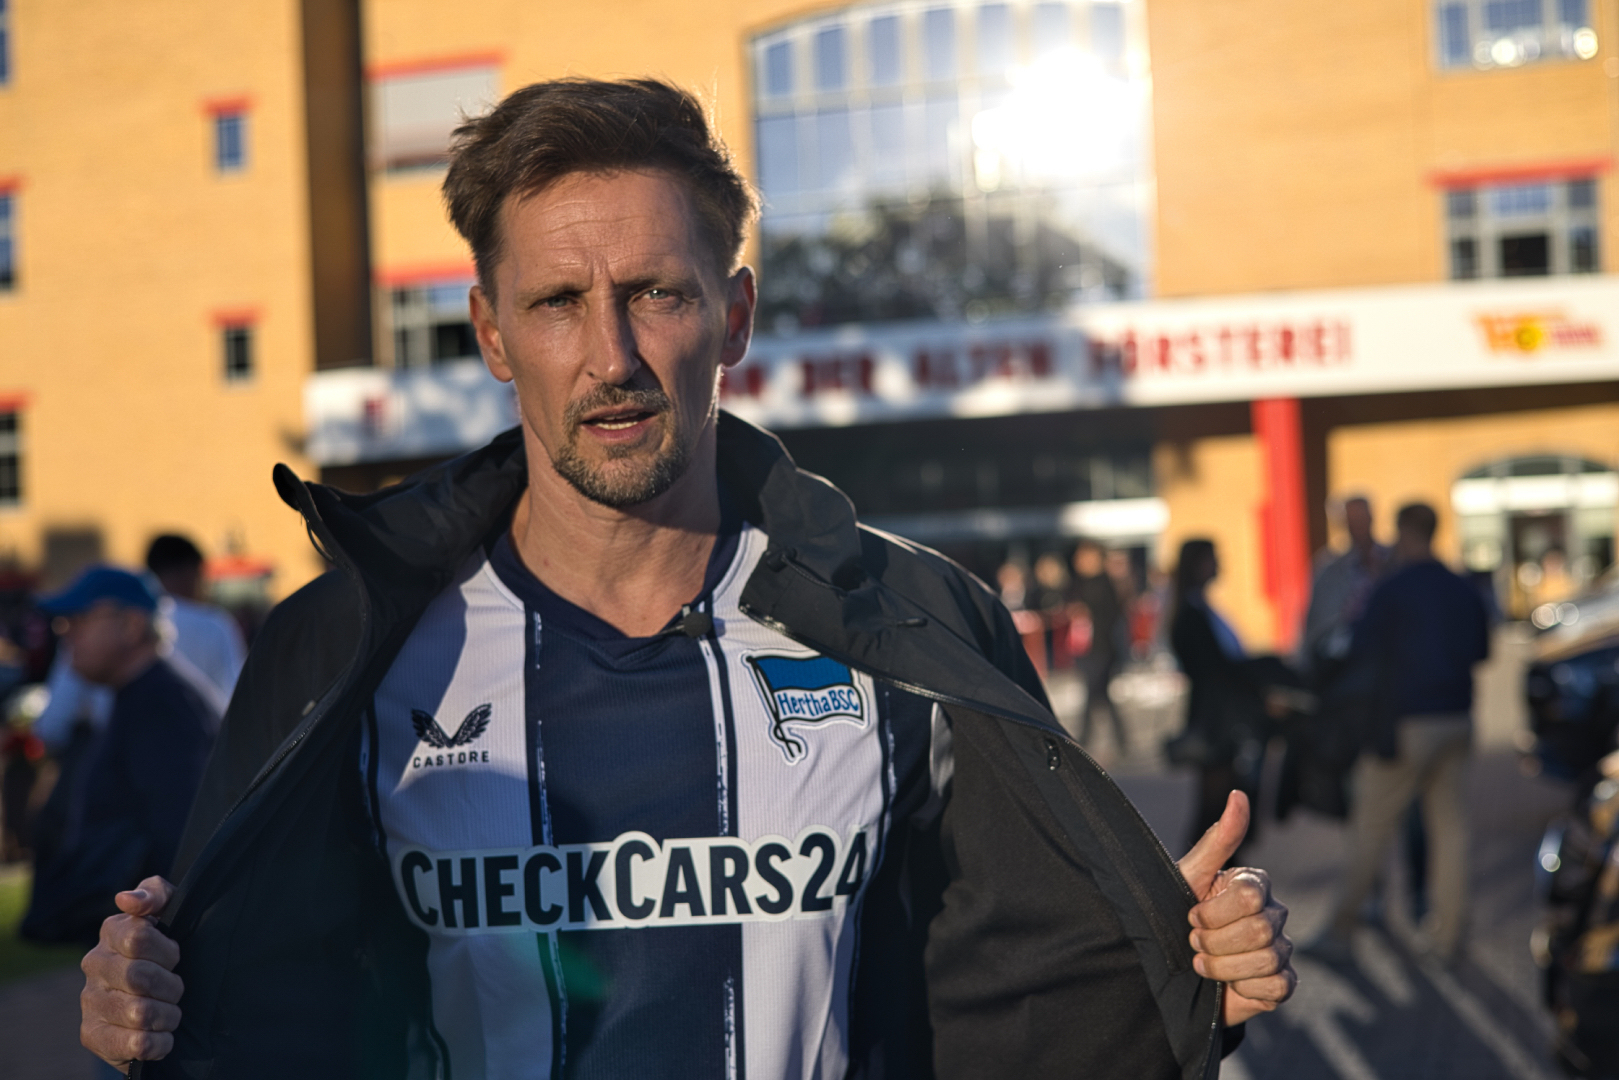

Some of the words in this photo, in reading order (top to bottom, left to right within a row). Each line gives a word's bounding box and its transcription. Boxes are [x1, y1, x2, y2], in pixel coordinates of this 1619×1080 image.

[777, 691, 831, 717] Hertha
[828, 689, 859, 712] BSC
[413, 751, 489, 769] CASTORE
